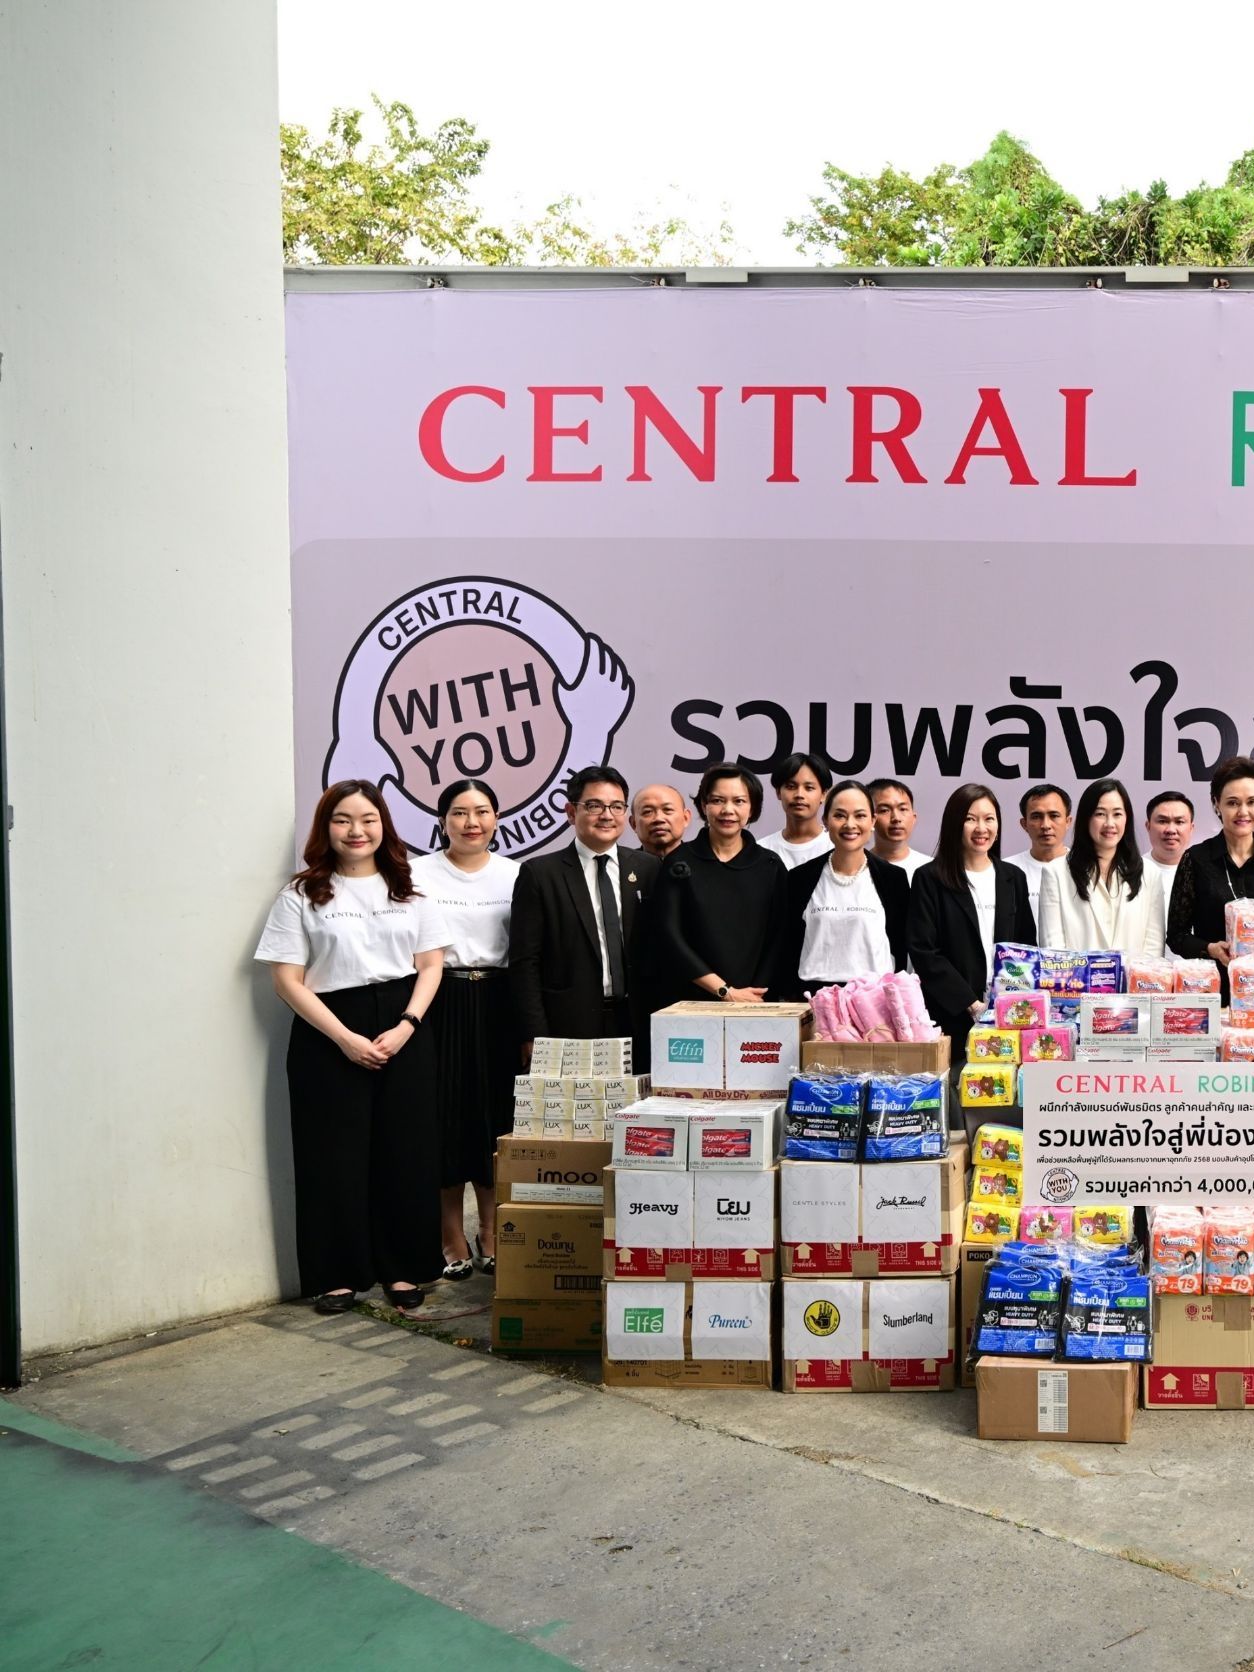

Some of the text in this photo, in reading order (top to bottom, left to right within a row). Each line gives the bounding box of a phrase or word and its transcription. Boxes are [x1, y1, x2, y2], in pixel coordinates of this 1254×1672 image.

[418, 385, 1138, 487] CENTRAL
[378, 589, 522, 650] CENTRAL
[387, 662, 541, 736] WITH
[411, 720, 536, 786] YOU
[437, 899, 468, 907] ENTRAL
[372, 908, 407, 917] ROBINSON
[740, 1042, 782, 1051] MICKEY
[740, 1054, 780, 1063] MOUSE
[1056, 1075, 1183, 1093] CENTRAL
[733, 1091, 749, 1099] Dry
[1039, 1101, 1162, 1112] ผนึกกำลังแบรนด์พันธมิตร
[1164, 1101, 1235, 1115] ลูกค้าคนสำคัญ
[537, 1168, 598, 1184] imoo
[1049, 1178, 1068, 1188] WITH
[1052, 1185, 1068, 1194] YOU
[1085, 1176, 1192, 1198] รวมมูลค่ากว่า
[629, 1203, 678, 1215] Heavy
[537, 1239, 575, 1253] Downy
[1180, 1279, 1194, 1289] 79
[1234, 1279, 1248, 1289] 79
[625, 1314, 662, 1332] Elfé
[709, 1314, 752, 1328] Pureen
[883, 1312, 933, 1328] Slumberland
